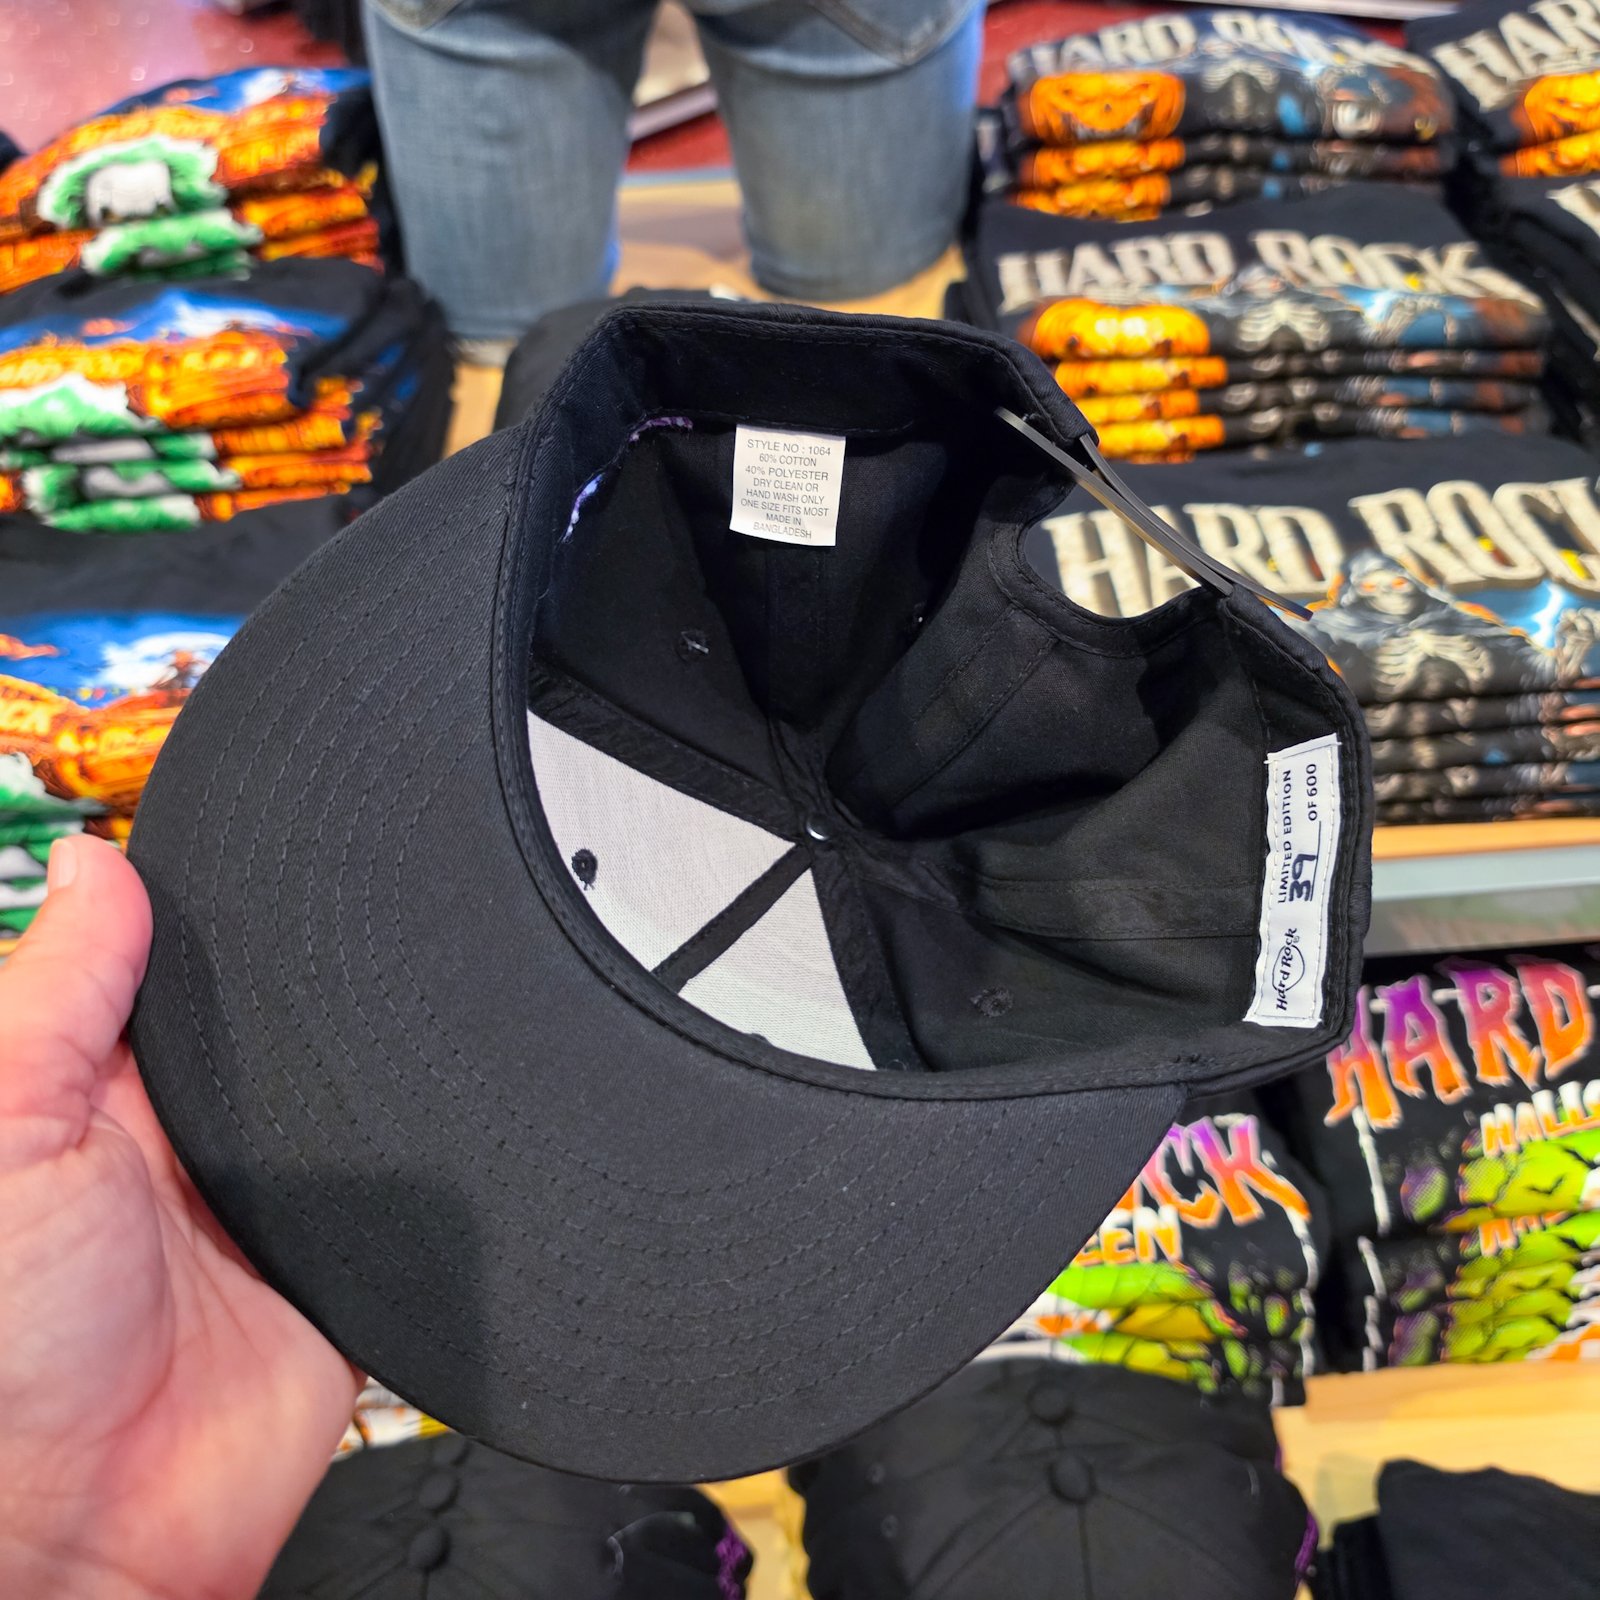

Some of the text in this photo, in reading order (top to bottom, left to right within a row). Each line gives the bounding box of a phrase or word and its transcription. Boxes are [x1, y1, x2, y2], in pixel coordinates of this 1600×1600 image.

[997, 229, 1544, 314] HARD ROCK
[747, 439, 780, 451] STYLE
[783, 443, 799, 453] NO
[808, 446, 831, 456] 1064
[759, 453, 817, 467] 60% COTTON
[745, 465, 829, 481] 40% POLYESTER
[753, 477, 819, 492] DRY CLEAN OR
[746, 488, 825, 505] HAND WASH ONLY
[740, 498, 829, 517] ONE SIZE FITS MOST
[766, 513, 802, 526] MADE IN
[753, 521, 812, 539] BANGLADESH
[1278, 769, 1293, 904] LIMITED EDITION
[1288, 763, 1318, 902] 39 OF 600
[1276, 969, 1290, 1011] Hard
[1324, 954, 1594, 1133] HARD
